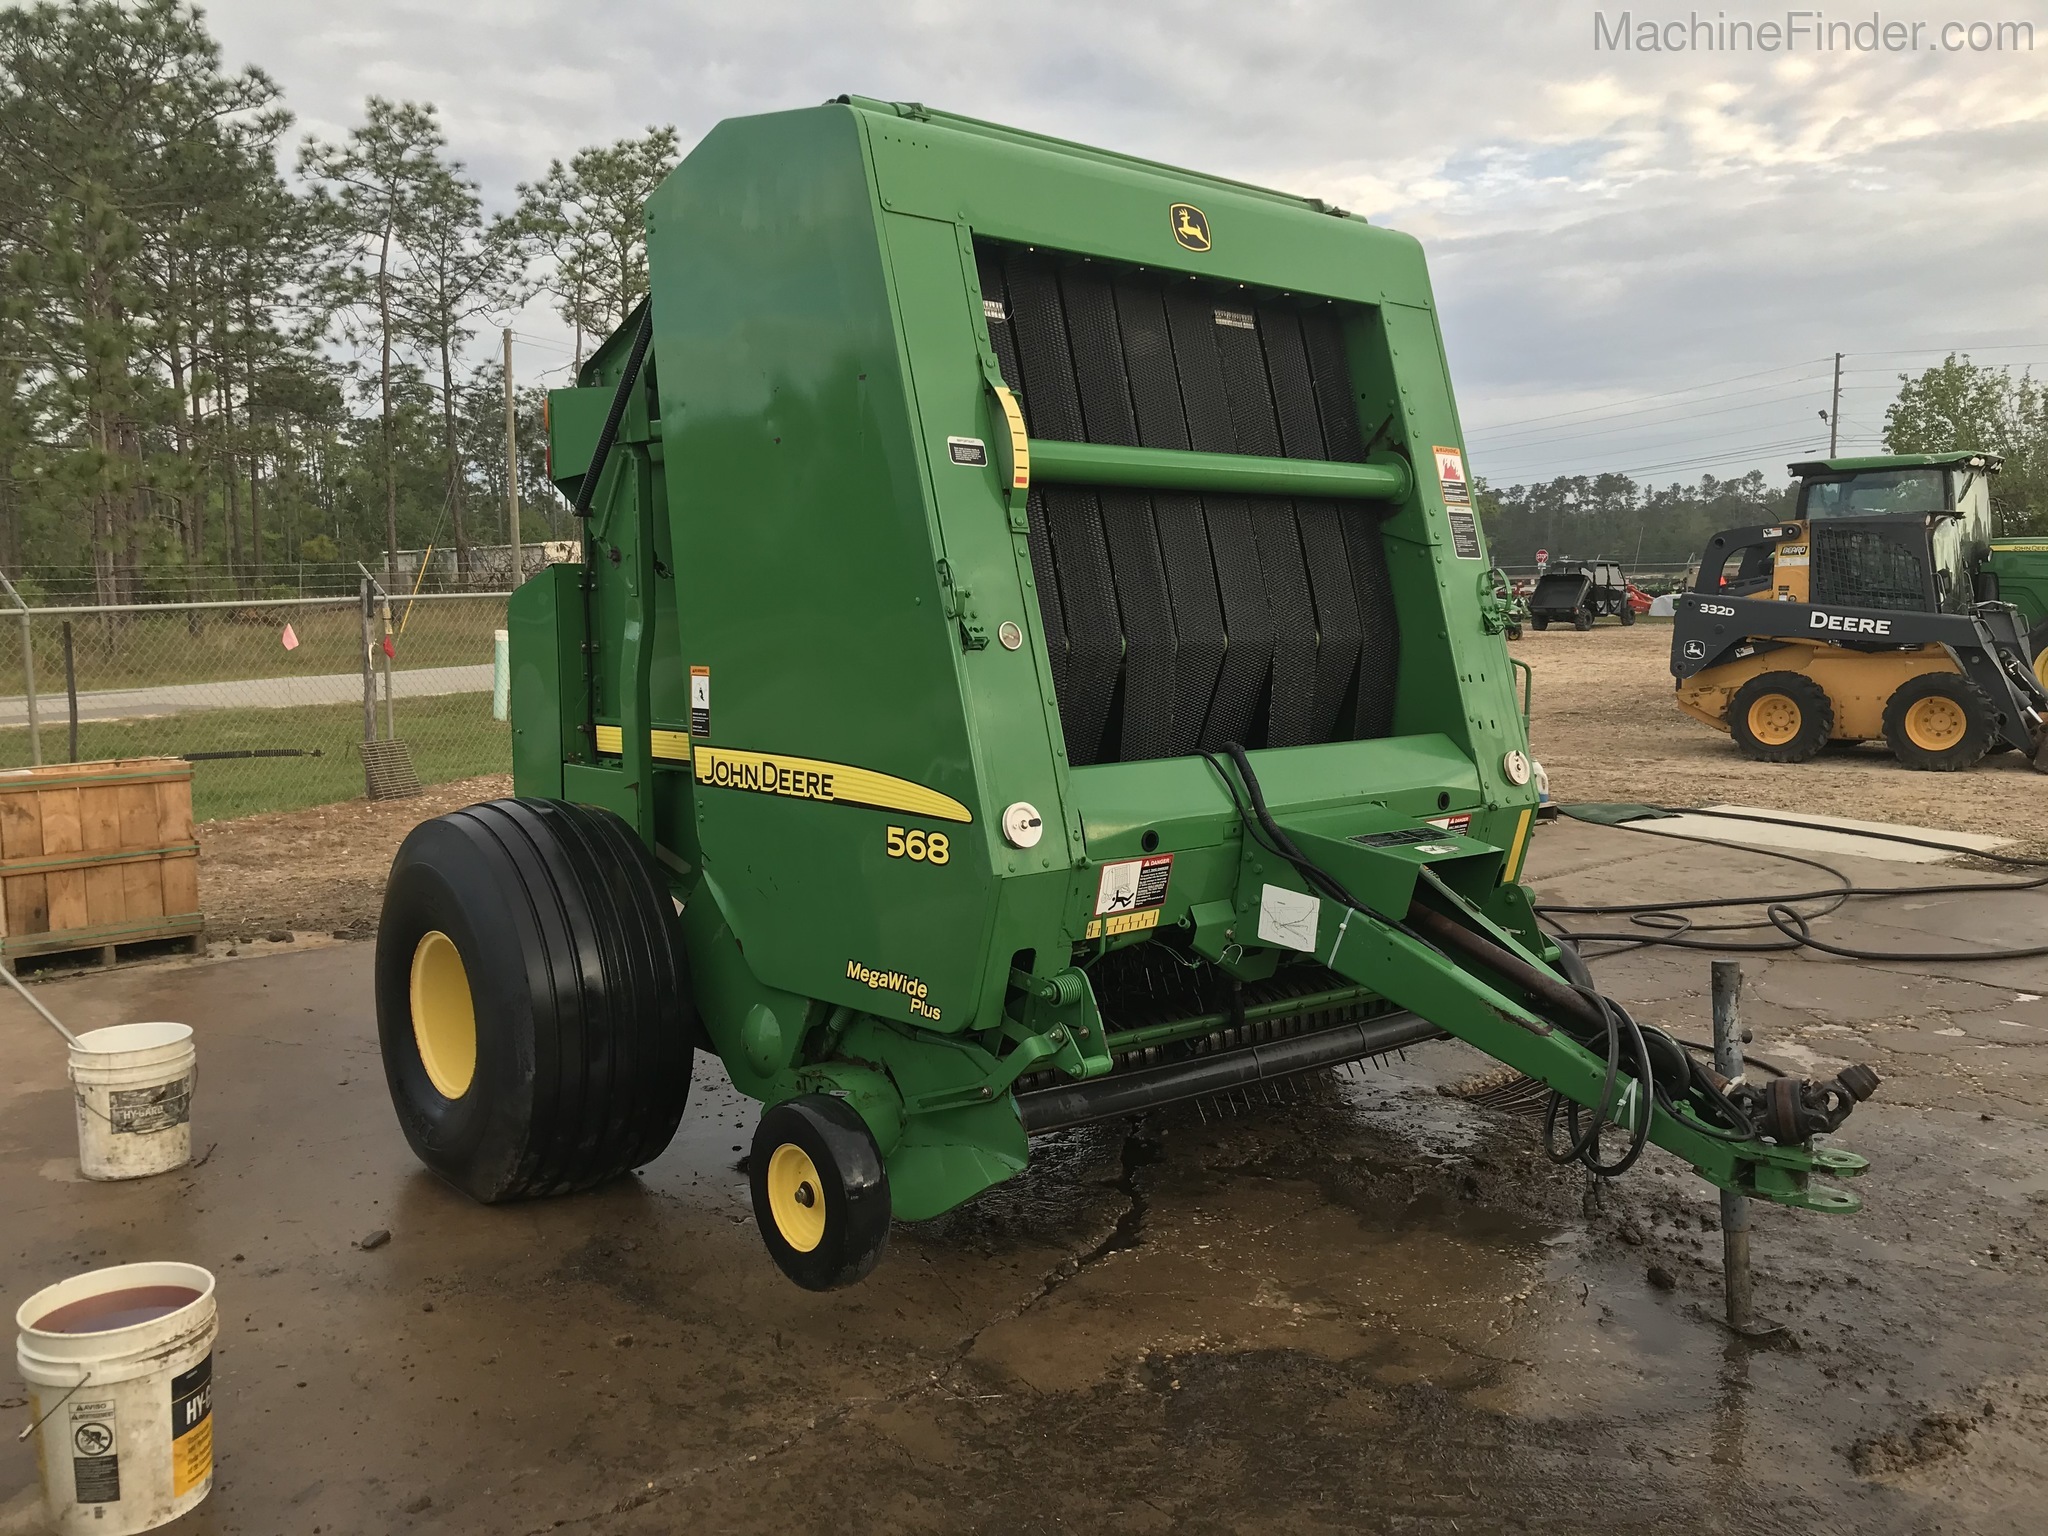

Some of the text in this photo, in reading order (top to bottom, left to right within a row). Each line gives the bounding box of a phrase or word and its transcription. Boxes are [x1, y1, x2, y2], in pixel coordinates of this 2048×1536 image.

[1700, 603, 1735, 616] 332D
[1809, 611, 1892, 635] DEERE
[704, 755, 834, 797] JOHN DEERE
[886, 825, 950, 865] 568
[1150, 858, 1170, 867] DANGER
[846, 960, 928, 998] MegaWide
[909, 998, 942, 1020] Plus
[123, 1105, 164, 1120] HY-GARD
